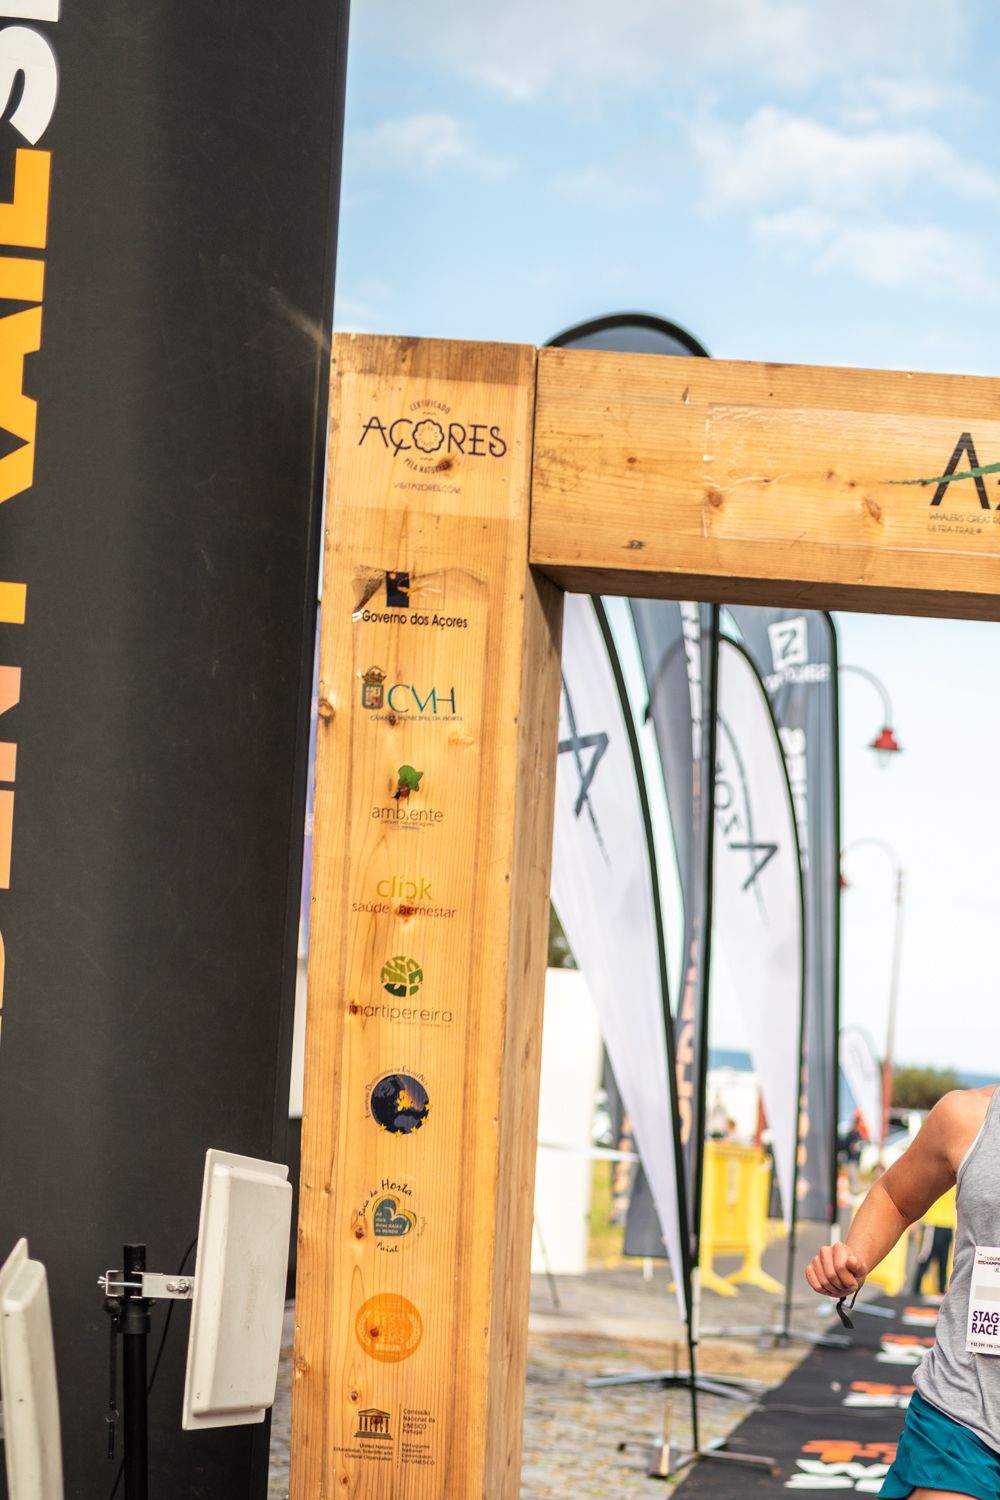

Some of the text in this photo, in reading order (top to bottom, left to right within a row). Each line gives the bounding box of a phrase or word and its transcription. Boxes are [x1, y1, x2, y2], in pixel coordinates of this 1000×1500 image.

[359, 416, 507, 458] AÇORES
[362, 610, 468, 630] Governo dos Açores
[971, 1323, 999, 1336] RACE
